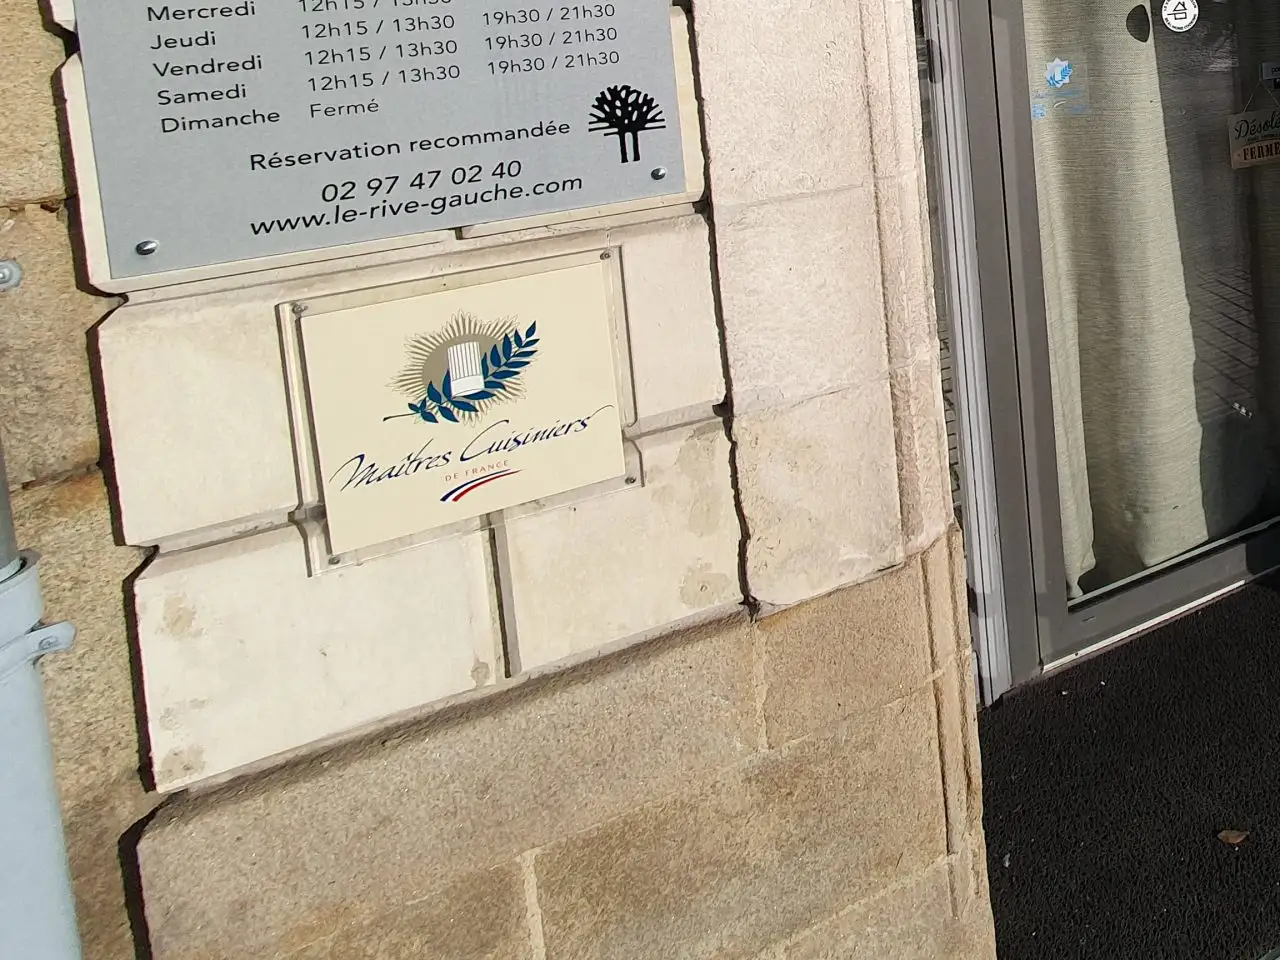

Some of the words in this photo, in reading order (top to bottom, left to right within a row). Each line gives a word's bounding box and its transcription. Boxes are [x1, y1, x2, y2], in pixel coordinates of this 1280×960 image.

[147, 0, 256, 22] Mercredi
[150, 30, 216, 50] Jeudi
[302, 20, 368, 39] 12h15
[375, 19, 384, 34] /
[393, 14, 455, 33] 13h30
[482, 8, 540, 26] 19h30
[546, 7, 554, 22] /
[560, 3, 615, 21] 21h30
[152, 54, 262, 77] Vendredi
[304, 46, 371, 66] 12h15
[379, 45, 387, 60] /
[395, 39, 458, 58] 13h30
[485, 33, 543, 51] 19h30
[548, 31, 556, 46] /
[562, 27, 618, 45] 21h30
[157, 83, 246, 106] Samedi
[308, 73, 375, 92] 12h15
[381, 71, 390, 86] /
[398, 64, 461, 84] 13h30
[487, 57, 545, 75] 19h30
[551, 55, 558, 70] /
[564, 50, 620, 69] 21h30
[161, 108, 280, 134] Dimanche
[309, 98, 379, 119] Fermé
[250, 142, 401, 171] Réservation
[409, 120, 571, 152] recommandée
[321, 181, 356, 203] 02
[366, 175, 400, 197] 97
[409, 170, 442, 190] 47
[451, 164, 483, 185] 02
[491, 160, 522, 179] 40
[250, 177, 582, 236] www.le-rive-gauche.com
[329, 438, 451, 492] Maîtres
[460, 405, 614, 461] Cuisiniers
[445, 474, 459, 482] DE
[465, 460, 509, 477] FRANCE
